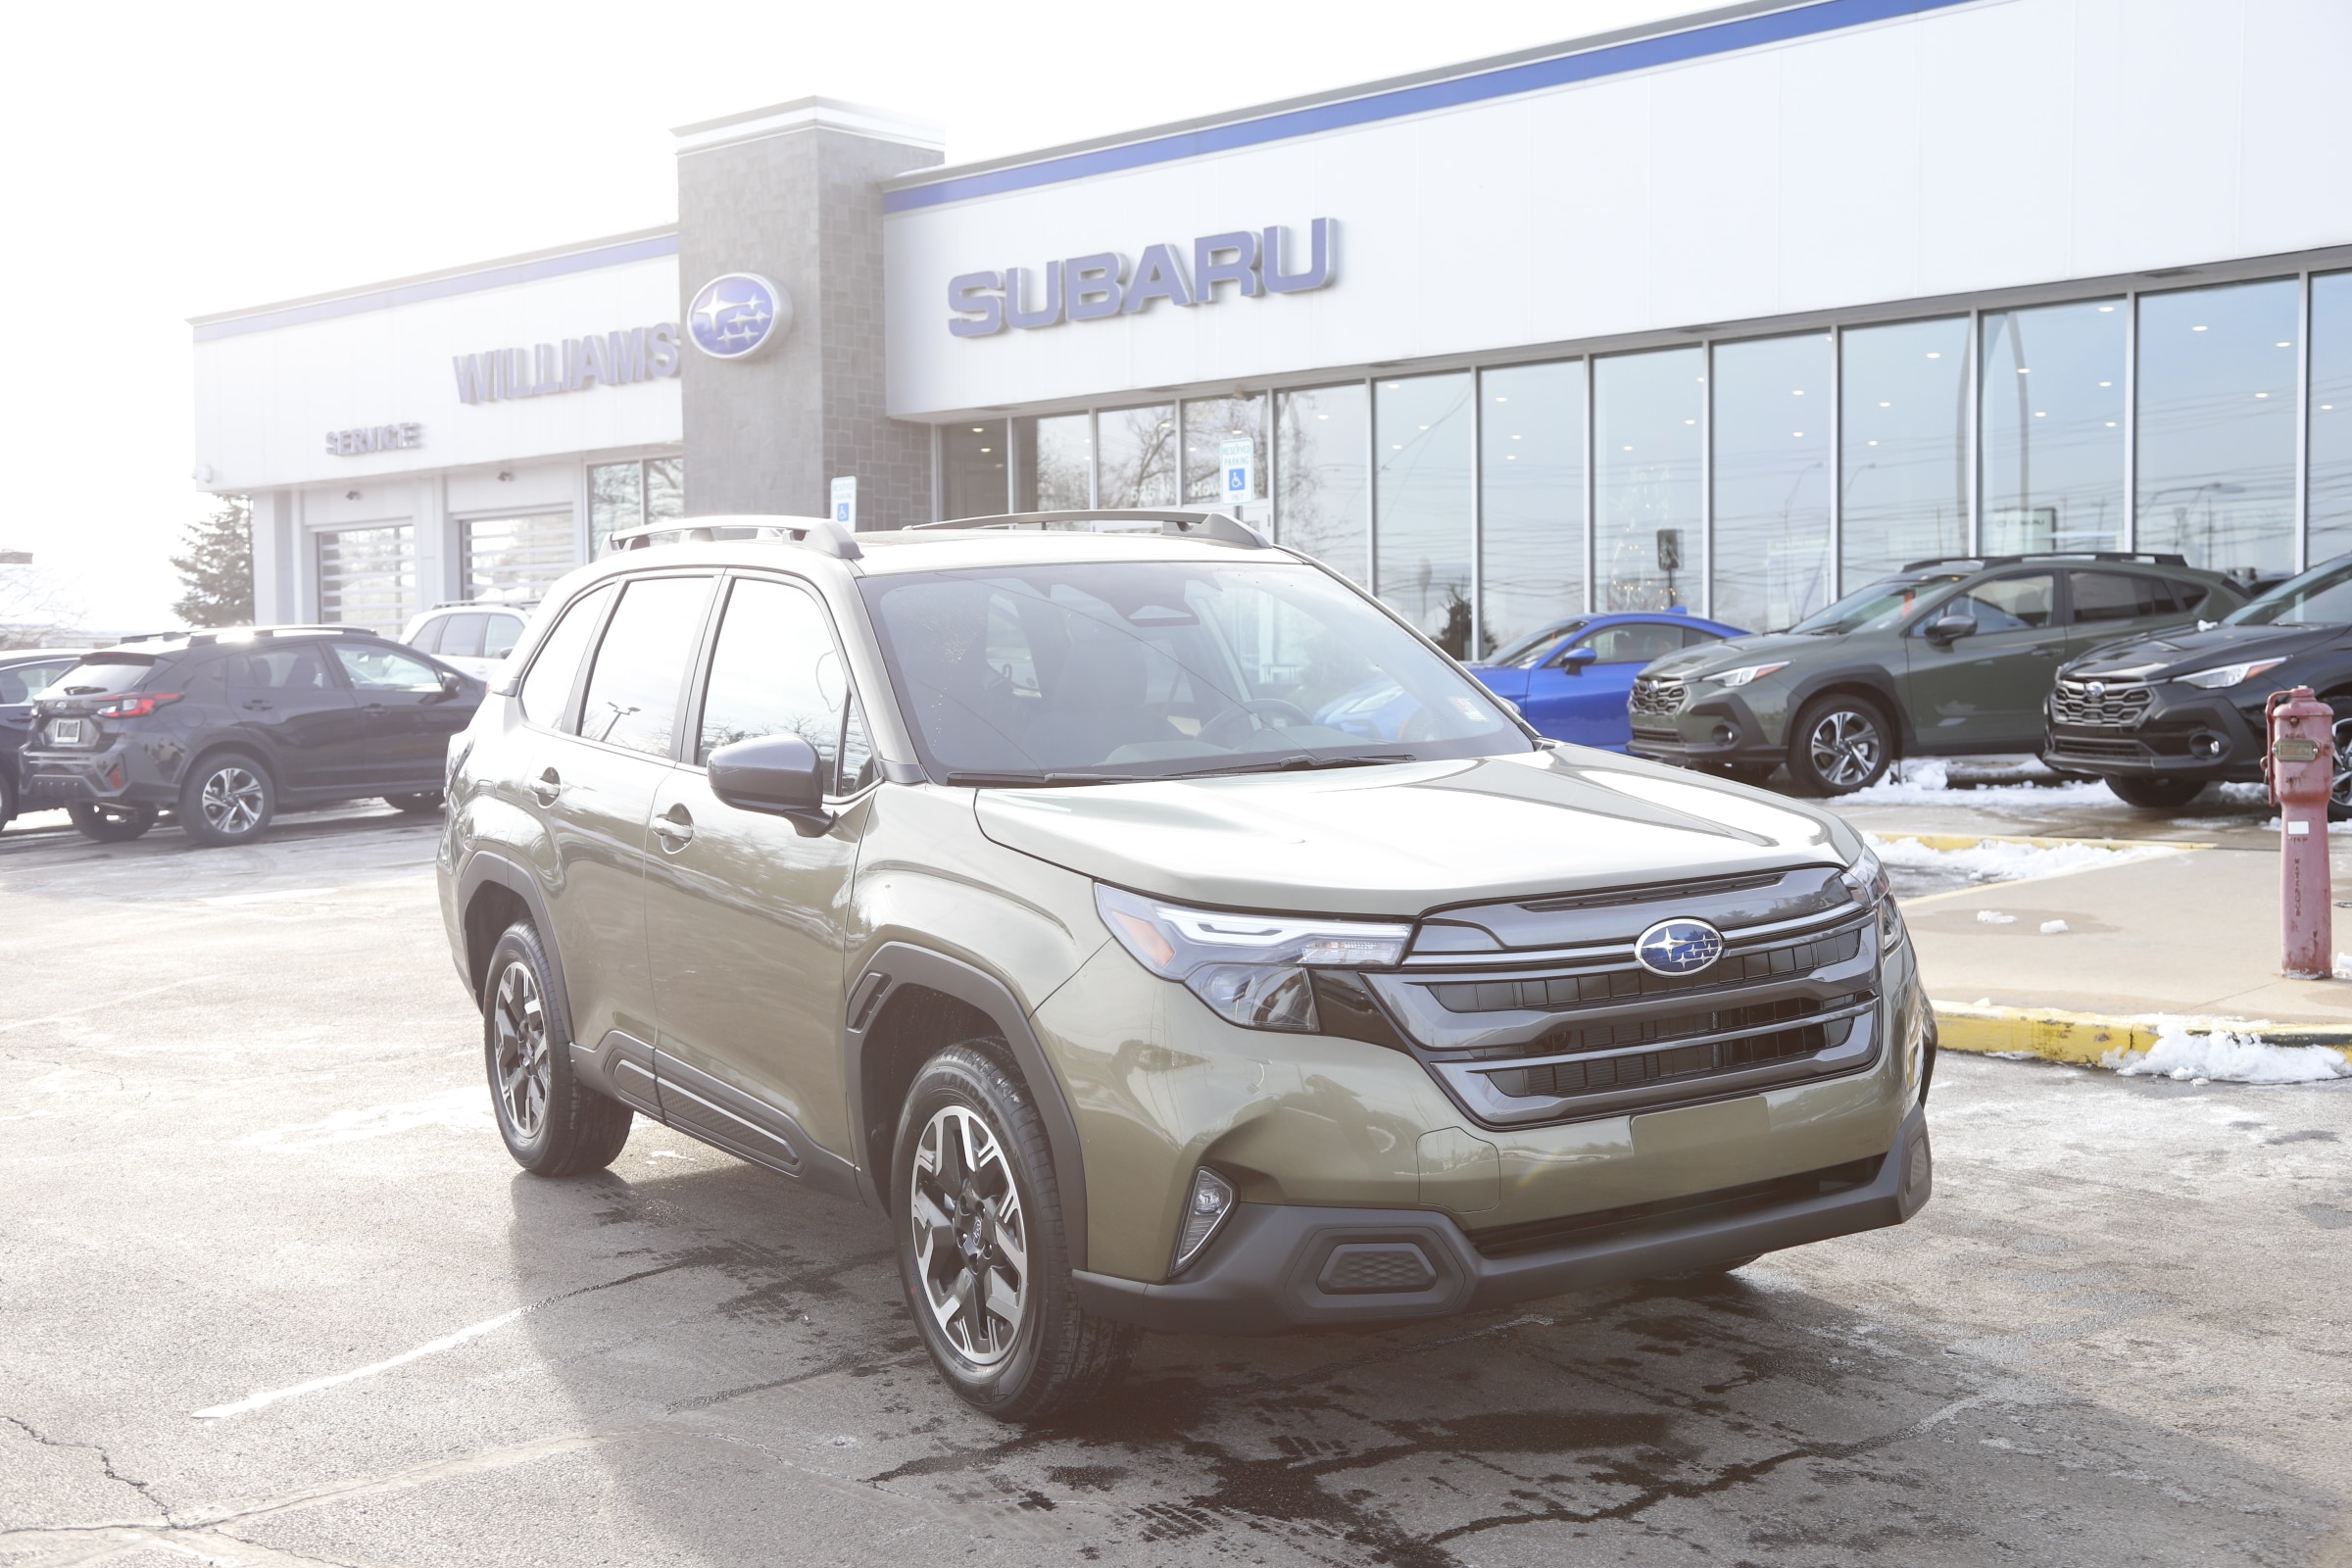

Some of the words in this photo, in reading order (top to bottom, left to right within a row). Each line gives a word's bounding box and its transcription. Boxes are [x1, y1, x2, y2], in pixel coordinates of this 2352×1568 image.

[948, 217, 1338, 338] SUBARU
[453, 321, 680, 404] WILLIAMS
[325, 422, 422, 456] SERVICE
[1222, 445, 1251, 455] RESERVED
[1224, 457, 1250, 466] PARKING
[1191, 481, 1221, 497] How
